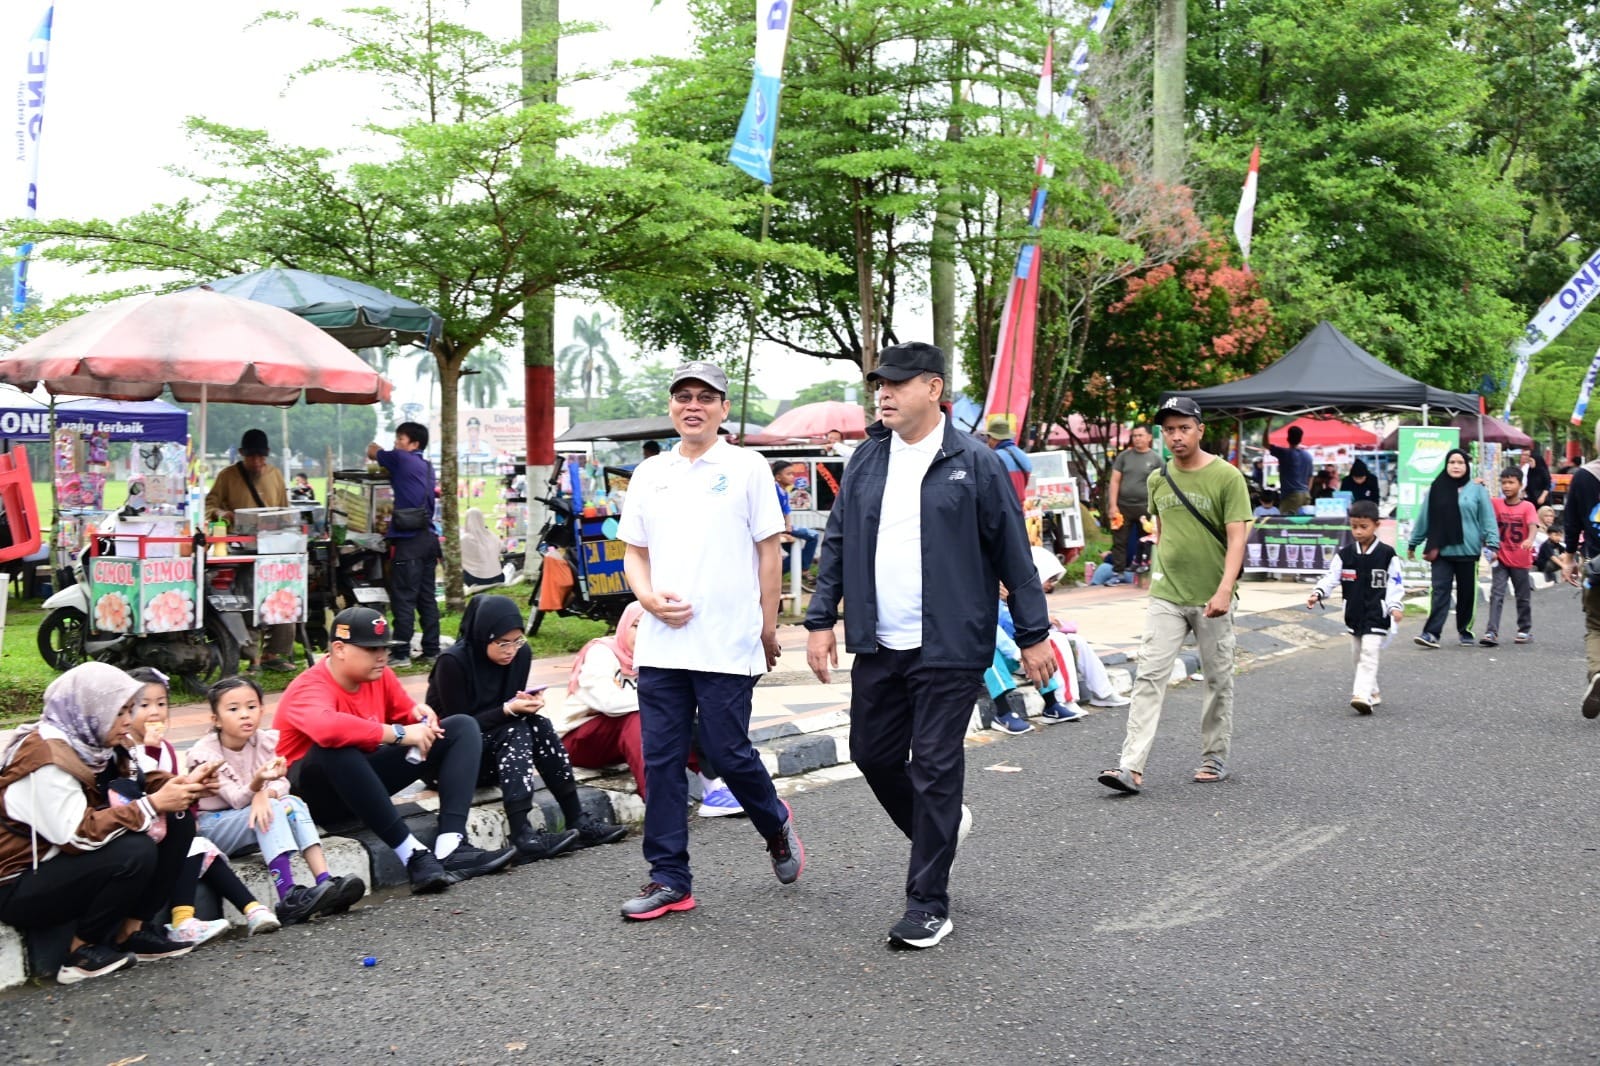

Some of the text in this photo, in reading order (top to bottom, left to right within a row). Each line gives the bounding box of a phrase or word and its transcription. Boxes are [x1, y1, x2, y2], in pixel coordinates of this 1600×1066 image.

[97, 420, 144, 434] terbaik
[1497, 521, 1523, 544] 75
[94, 561, 135, 586] CIMOL
[143, 559, 195, 584] CIMOL
[257, 562, 304, 582] CIMOL
